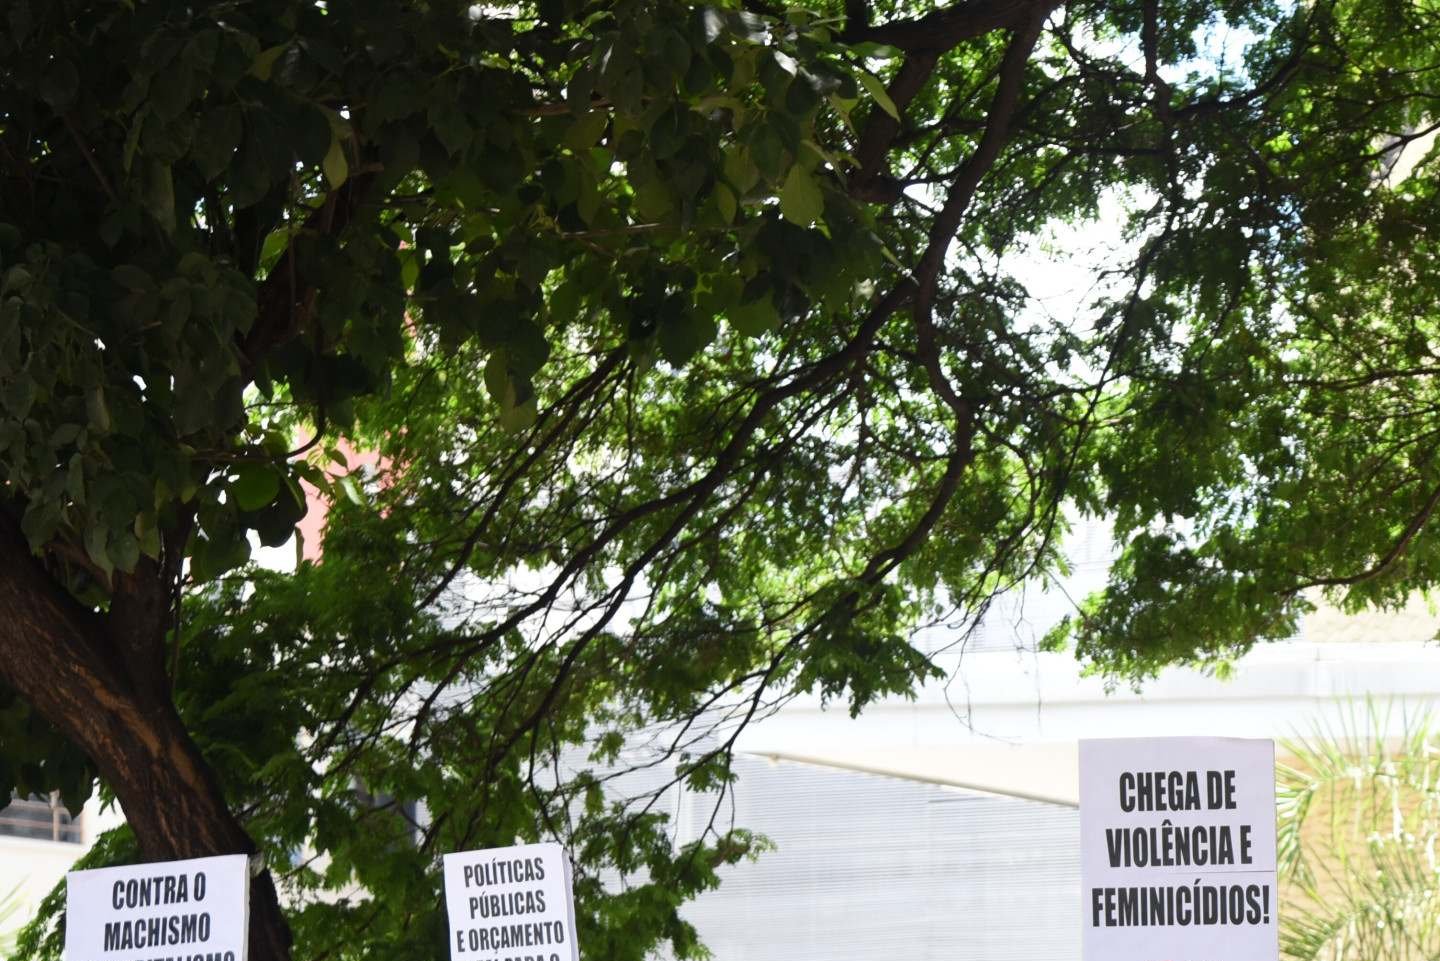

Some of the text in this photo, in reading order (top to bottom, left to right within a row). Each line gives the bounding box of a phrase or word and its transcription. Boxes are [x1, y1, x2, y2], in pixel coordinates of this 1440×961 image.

[1120, 770, 1236, 812] CHEGA DE
[1106, 819, 1252, 868] VIOLÊNCIA E
[112, 872, 206, 910] CONTRA O
[464, 858, 544, 887] POLÍTICAS
[470, 890, 546, 919] PÚBLICAS
[1092, 878, 1270, 927] FEMINICÍDIOS!
[104, 912, 210, 952] MACHISMO
[457, 921, 564, 952] E ORÇAMENTO
